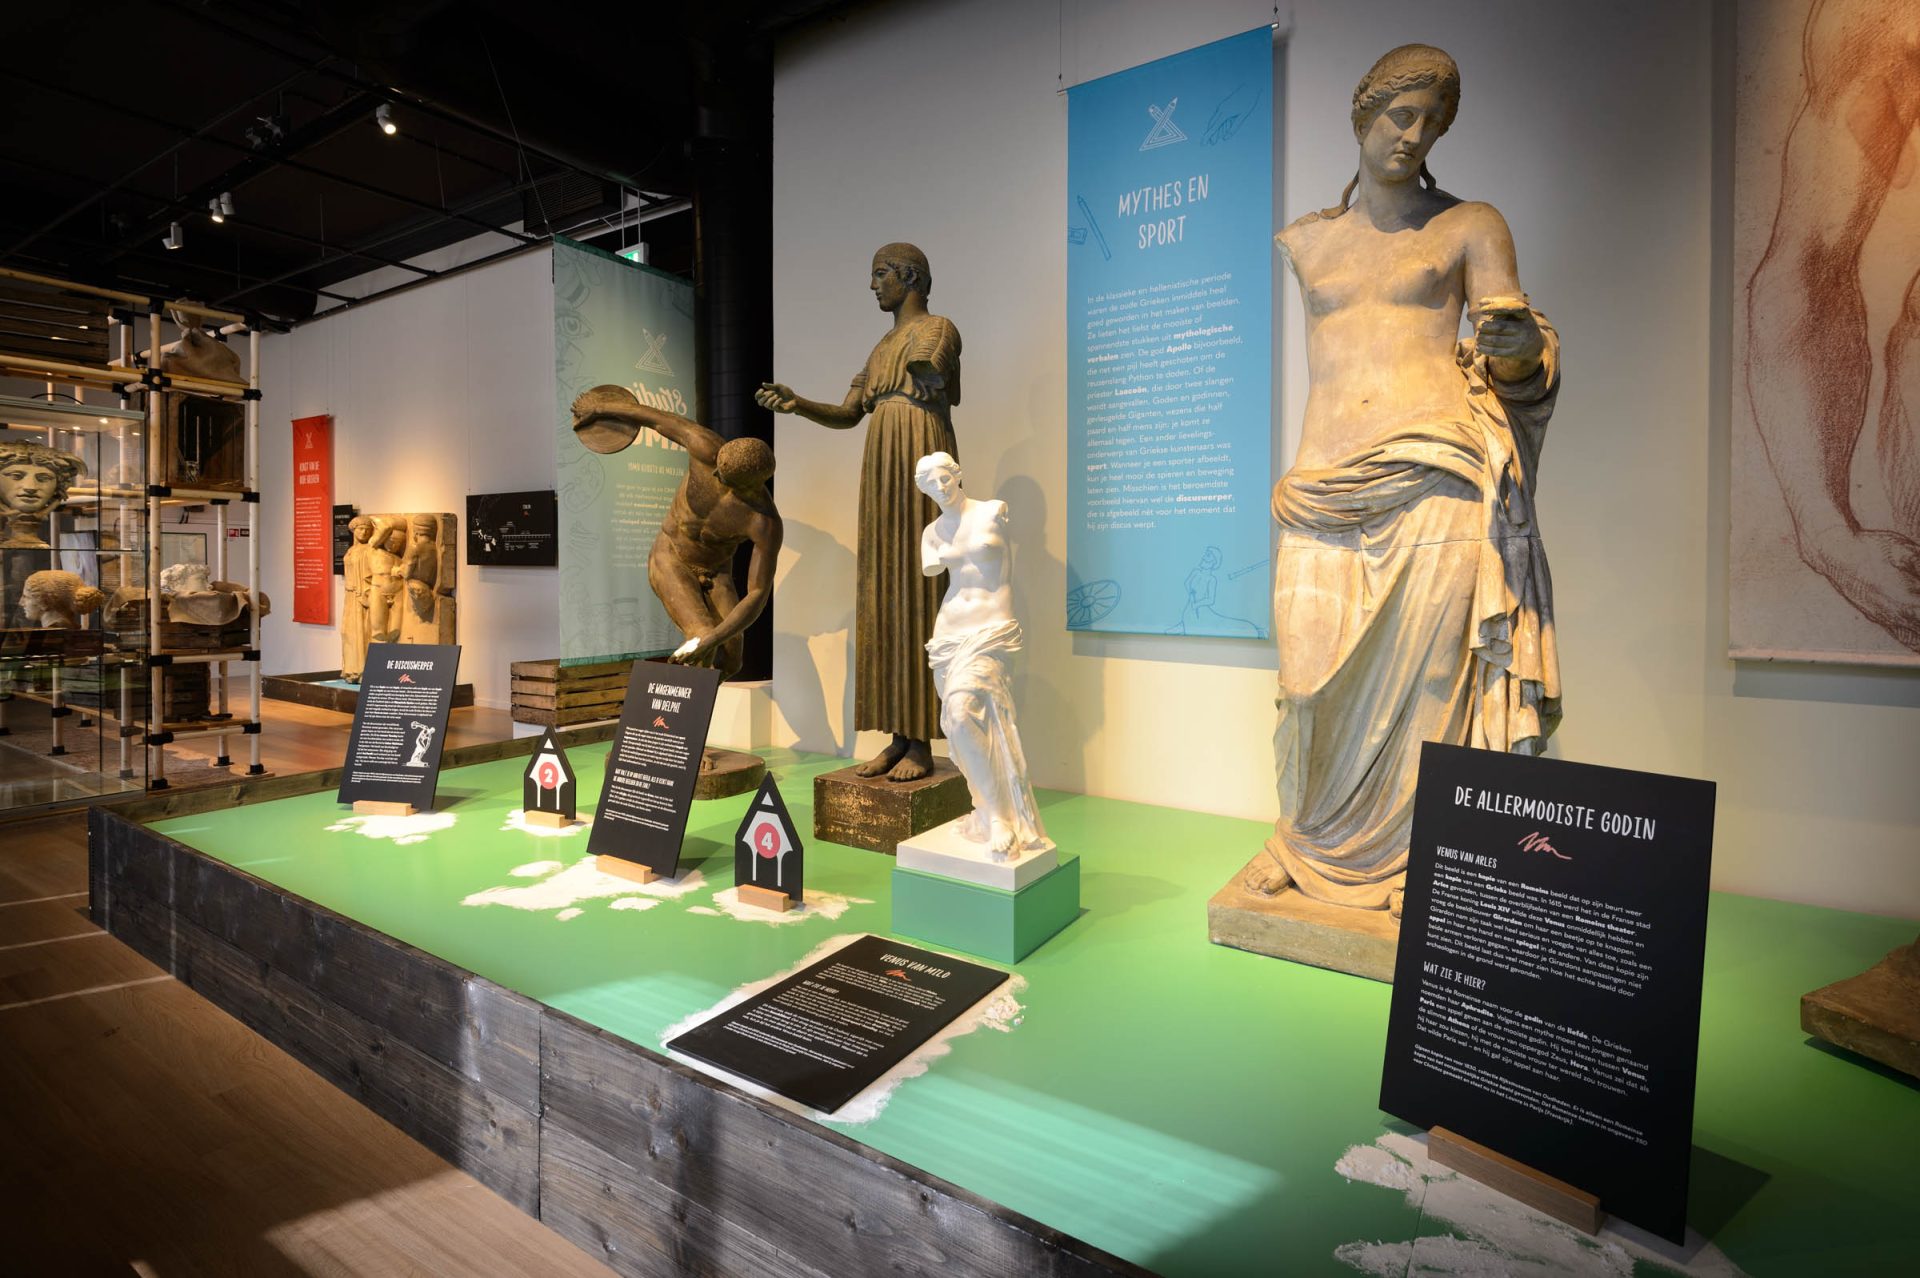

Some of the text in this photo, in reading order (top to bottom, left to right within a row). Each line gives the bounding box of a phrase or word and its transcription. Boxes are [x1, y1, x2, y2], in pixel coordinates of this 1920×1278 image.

[1118, 174, 1209, 218] MYTHES EN
[1139, 215, 1186, 249] SPORT
[387, 660, 433, 670] DE DISCUSWERPER
[648, 683, 655, 693] DE
[652, 699, 662, 709] VAN
[544, 768, 552, 783] 2
[1454, 786, 1656, 840] DE ALLERMOOISTE GODIN
[761, 832, 773, 850] 4
[1436, 846, 1497, 868] VENUS VAN ARLES
[1433, 879, 1448, 888] Arles
[1450, 885, 1479, 896] gevonden,
[1479, 890, 1498, 901] tussen
[1575, 915, 1605, 928] Romeins
[1435, 861, 1443, 869] Dit
[1444, 864, 1459, 873] beeld
[1478, 872, 1495, 882] kopie
[1520, 882, 1549, 895] Romeins
[1550, 889, 1568, 899] beeld
[1569, 894, 1580, 902] dat
[1592, 900, 1603, 908] zijn
[1605, 902, 1623, 913] beurt
[1445, 873, 1461, 883] kopie
[1486, 883, 1507, 894] Grieks
[1508, 888, 1525, 898] beeld
[1580, 906, 1591, 915] het
[1601, 911, 1610, 919] de
[1611, 914, 1634, 925] Franse
[1636, 921, 1651, 929] stad
[1441, 889, 1459, 900] Franse
[1480, 900, 1496, 910] Louis
[1498, 904, 1510, 913] XIV
[1512, 908, 1527, 918] wilde
[1528, 912, 1543, 922] deze
[1544, 916, 1565, 927] Venus
[1608, 933, 1634, 945] hebben
[1429, 915, 1445, 924] appel
[1453, 920, 1465, 929] haar
[1478, 927, 1493, 937] hand
[1516, 939, 1539, 950] spiegel
[1548, 947, 1556, 955] de
[1584, 957, 1596, 966] Van
[1598, 961, 1614, 971] deze
[1616, 966, 1635, 977] kopie
[1637, 972, 1649, 981] zijn
[880, 954, 951, 979] VENUS VAN MILO
[1423, 961, 1486, 990] WAT ZIE JE HIER?
[1422, 978, 1438, 989] Venus
[1444, 986, 1452, 994] de
[1453, 989, 1481, 1004] Romeinse
[1482, 1000, 1498, 1009] naam
[1499, 1006, 1513, 1014] voor
[1515, 1009, 1523, 1018] de
[1524, 1014, 1543, 1024] godin
[1557, 1023, 1565, 1032] de
[1592, 1035, 1602, 1044] De
[1603, 1039, 1632, 1054] Grieken
